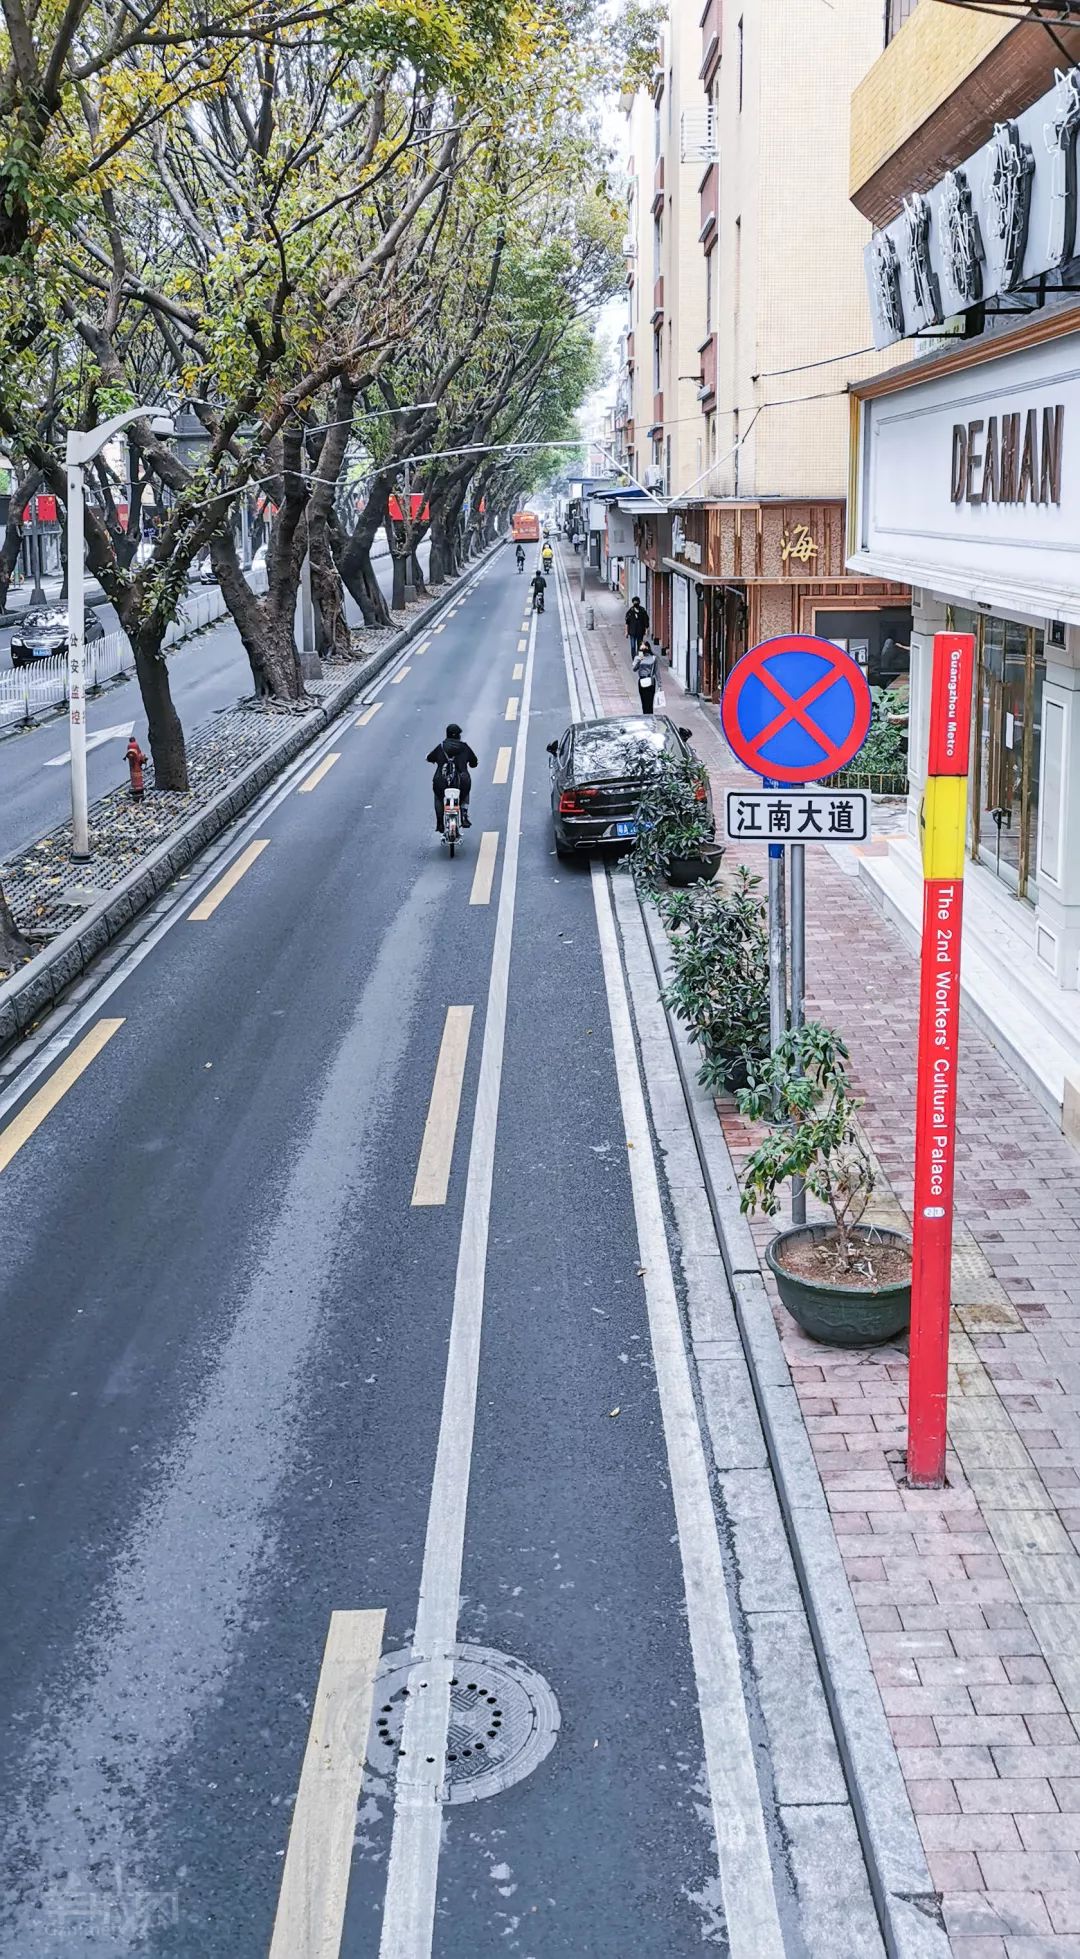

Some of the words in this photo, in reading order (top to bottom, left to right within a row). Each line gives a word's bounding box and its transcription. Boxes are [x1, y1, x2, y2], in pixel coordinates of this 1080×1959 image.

[950, 404, 1065, 503] DEAMAN
[779, 523, 819, 563] 海
[947, 651, 960, 718] Guangzhou
[946, 721, 957, 757] Metro
[736, 799, 855, 833] 江南大道
[937, 885, 953, 920] The
[936, 929, 953, 963] 2nd
[934, 971, 951, 1050] Workers'
[932, 1058, 950, 1128] Cultural
[930, 1135, 948, 1195] Palace
